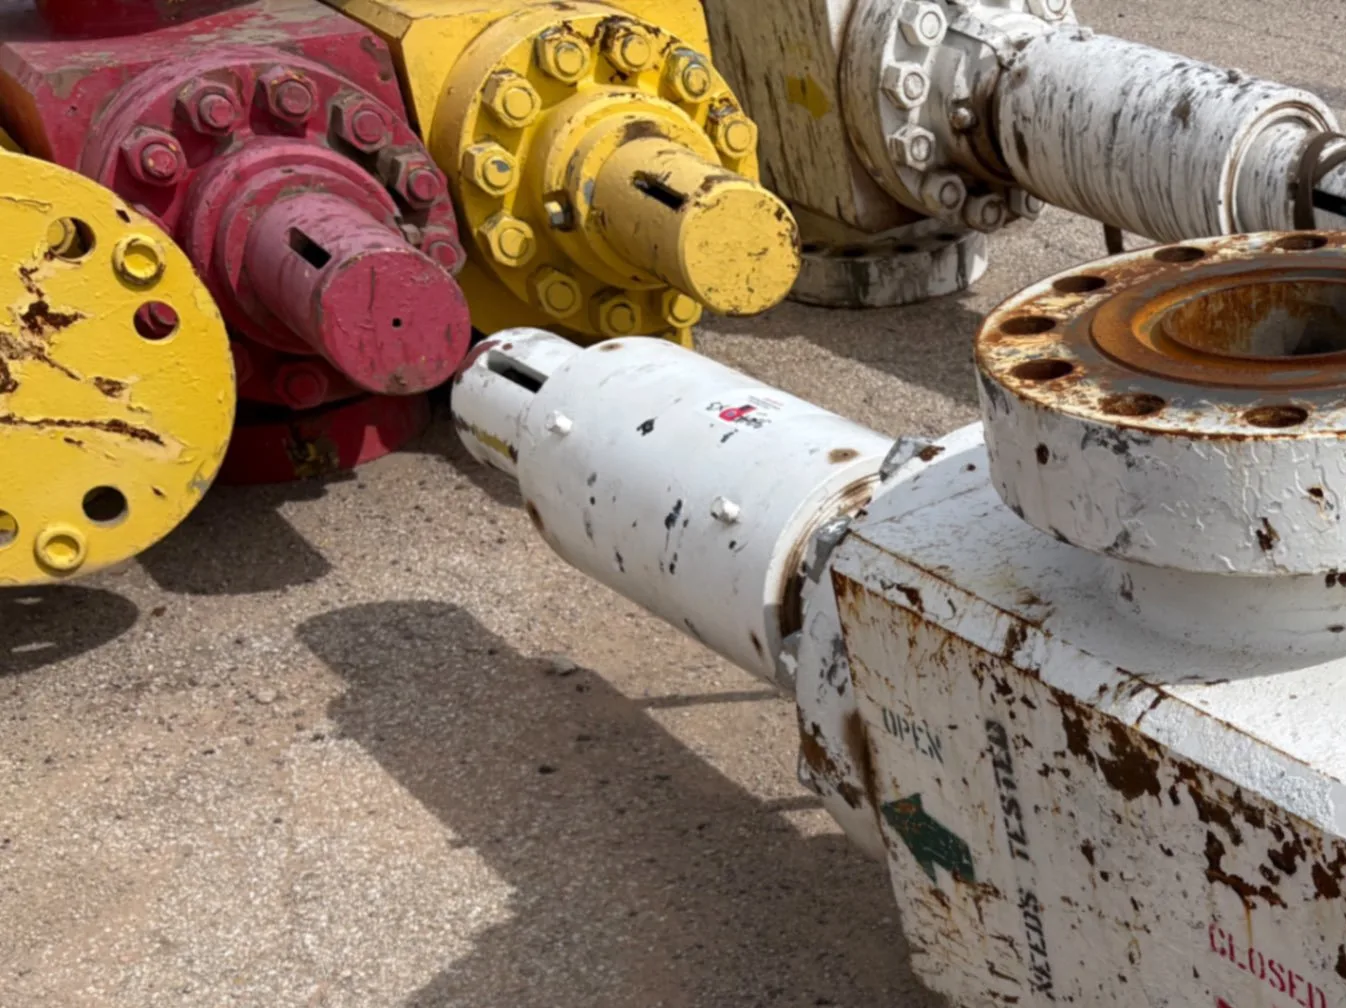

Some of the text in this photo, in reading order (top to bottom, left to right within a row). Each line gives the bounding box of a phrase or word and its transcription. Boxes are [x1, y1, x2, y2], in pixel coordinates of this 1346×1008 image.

[882, 706, 945, 765] OPEN
[985, 719, 1056, 1001] NEEDS TESTED
